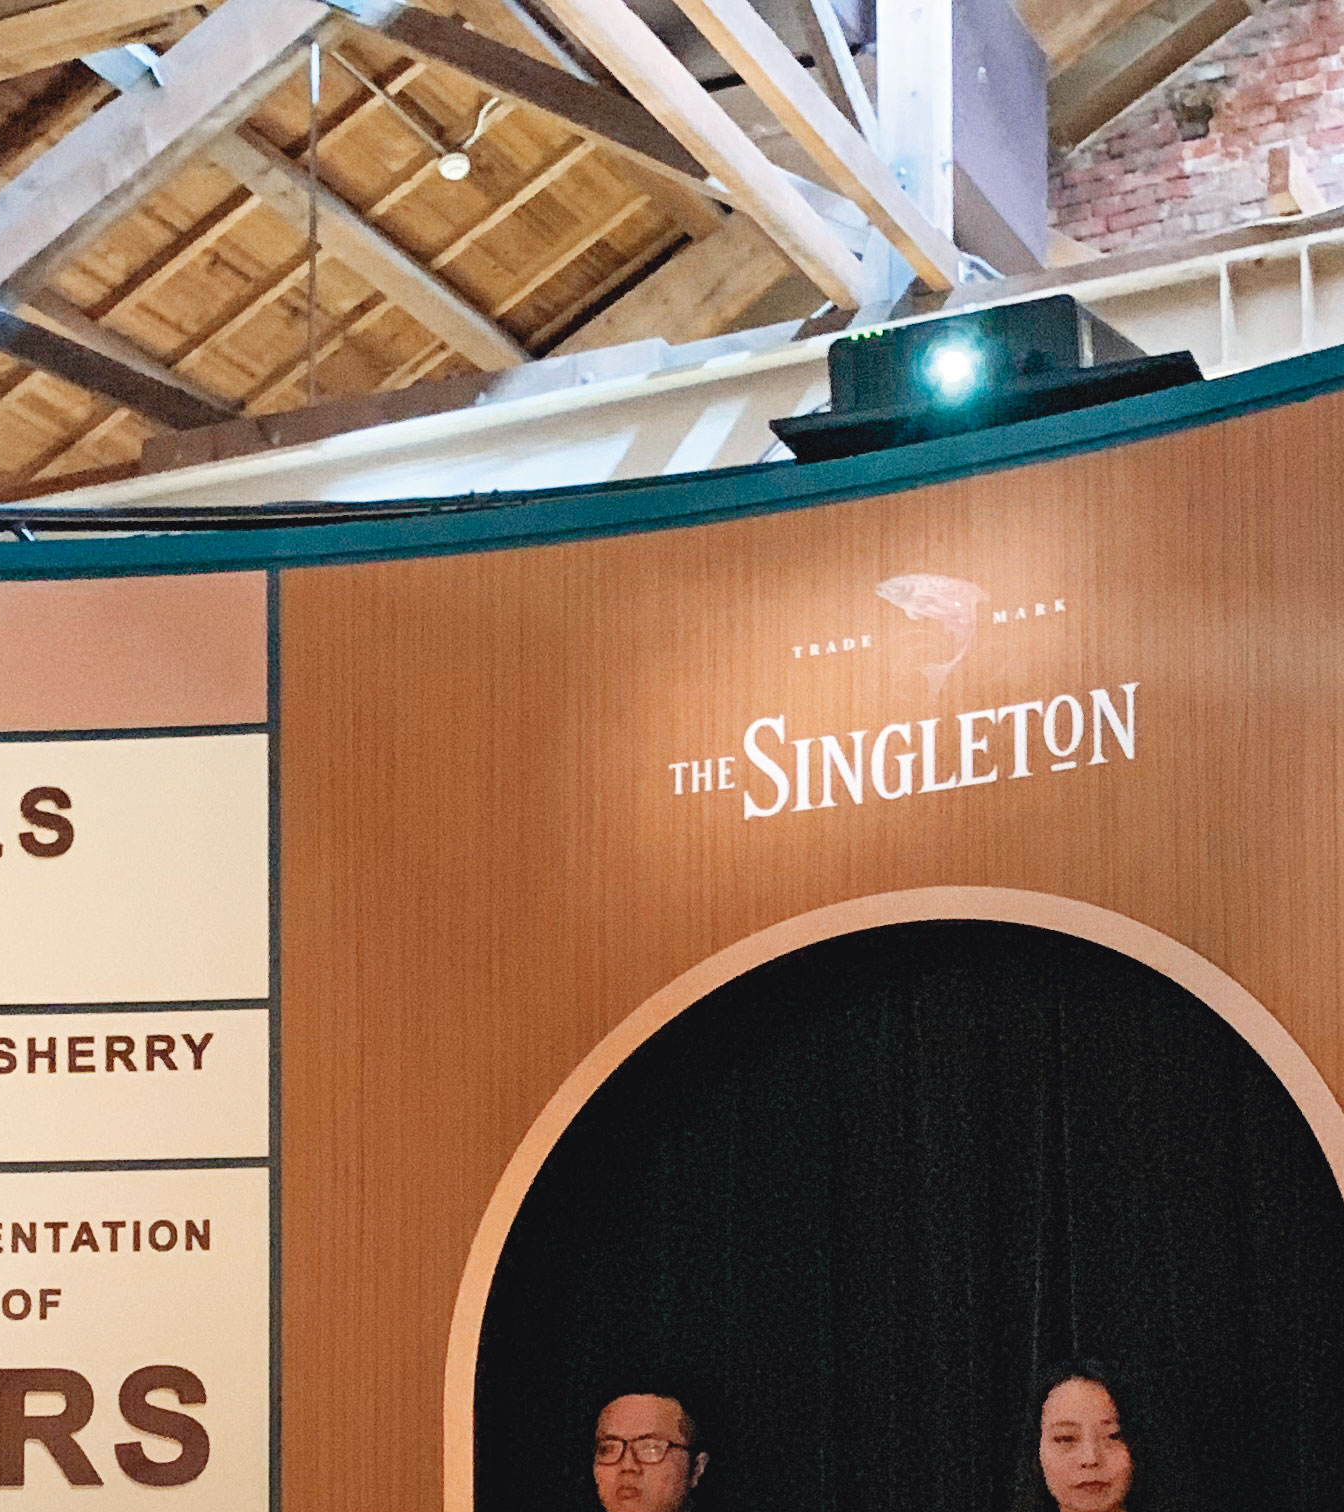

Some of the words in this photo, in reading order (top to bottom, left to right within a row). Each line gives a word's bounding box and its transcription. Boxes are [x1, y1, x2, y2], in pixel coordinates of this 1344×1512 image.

[791, 633, 873, 660] TRADE
[991, 597, 1067, 625] MARK
[668, 756, 737, 796] THE
[742, 681, 1141, 821] SINGLETON
[0, 1287, 63, 1322] OF
